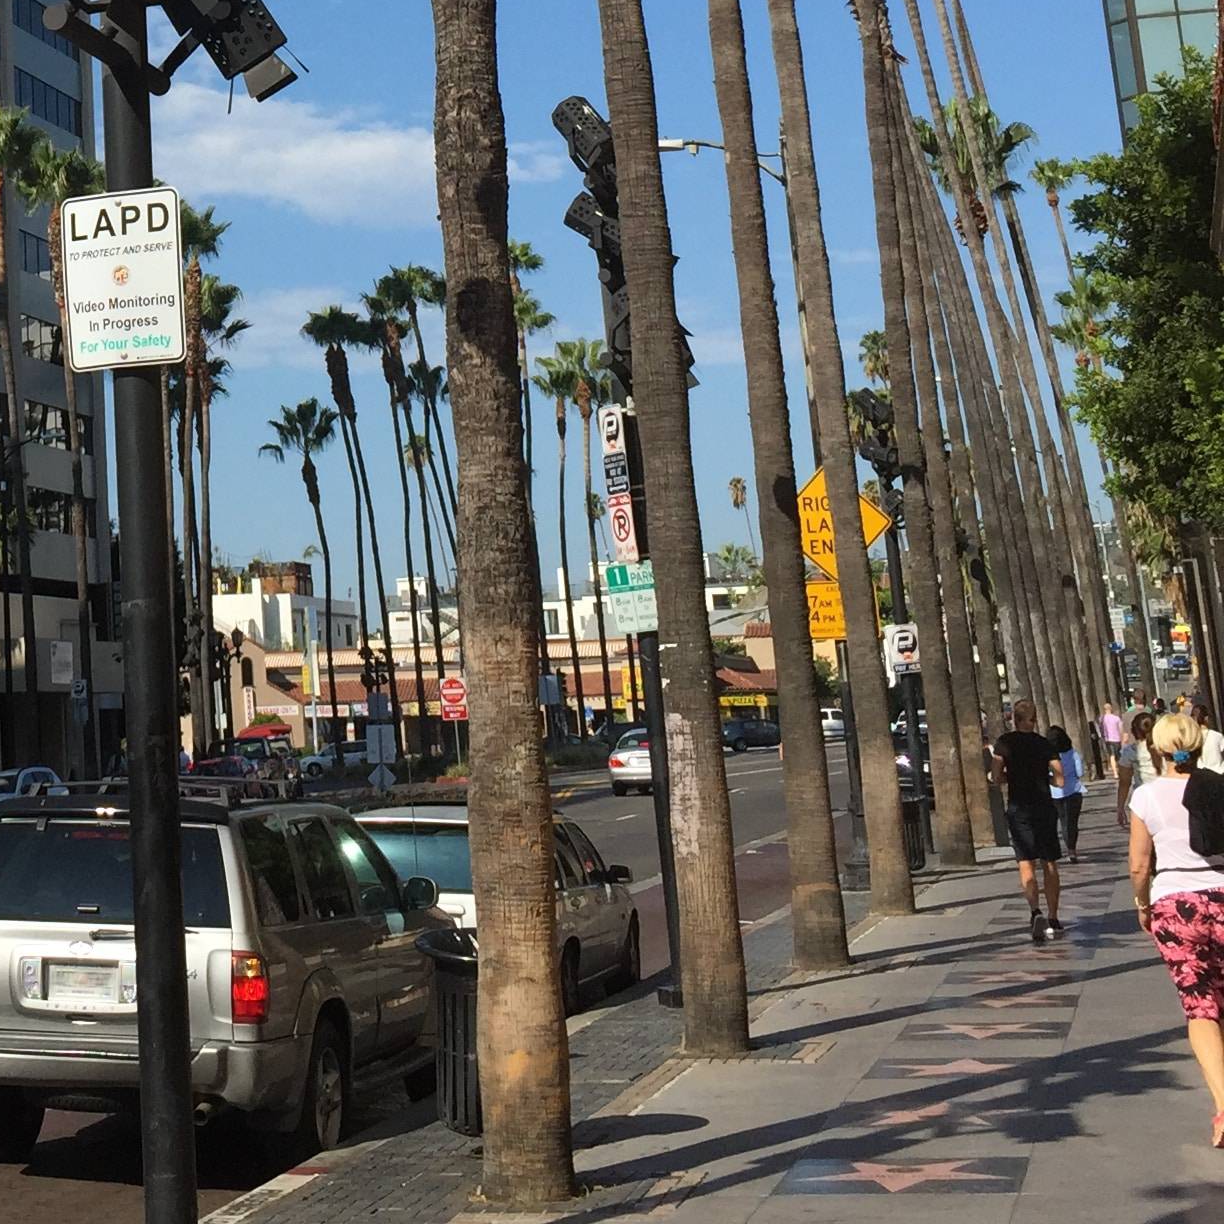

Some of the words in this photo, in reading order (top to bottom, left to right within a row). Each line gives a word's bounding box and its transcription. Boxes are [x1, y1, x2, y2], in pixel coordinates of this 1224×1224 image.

[70, 202, 169, 242] LAPD
[69, 252, 80, 261] TO
[81, 246, 121, 258] PROTECT
[122, 244, 142, 255] AND
[143, 241, 173, 252] SERVE
[73, 301, 105, 314] Video
[108, 293, 175, 310] Monitoring
[89, 320, 100, 332] In
[102, 316, 159, 331] Progress
[80, 341, 99, 353] For
[102, 338, 128, 350] Your
[132, 333, 171, 349] Safety
[802, 496, 830, 512] RIG
[807, 518, 831, 533] LA
[810, 539, 834, 555] EN
[613, 568, 621, 585] 1
